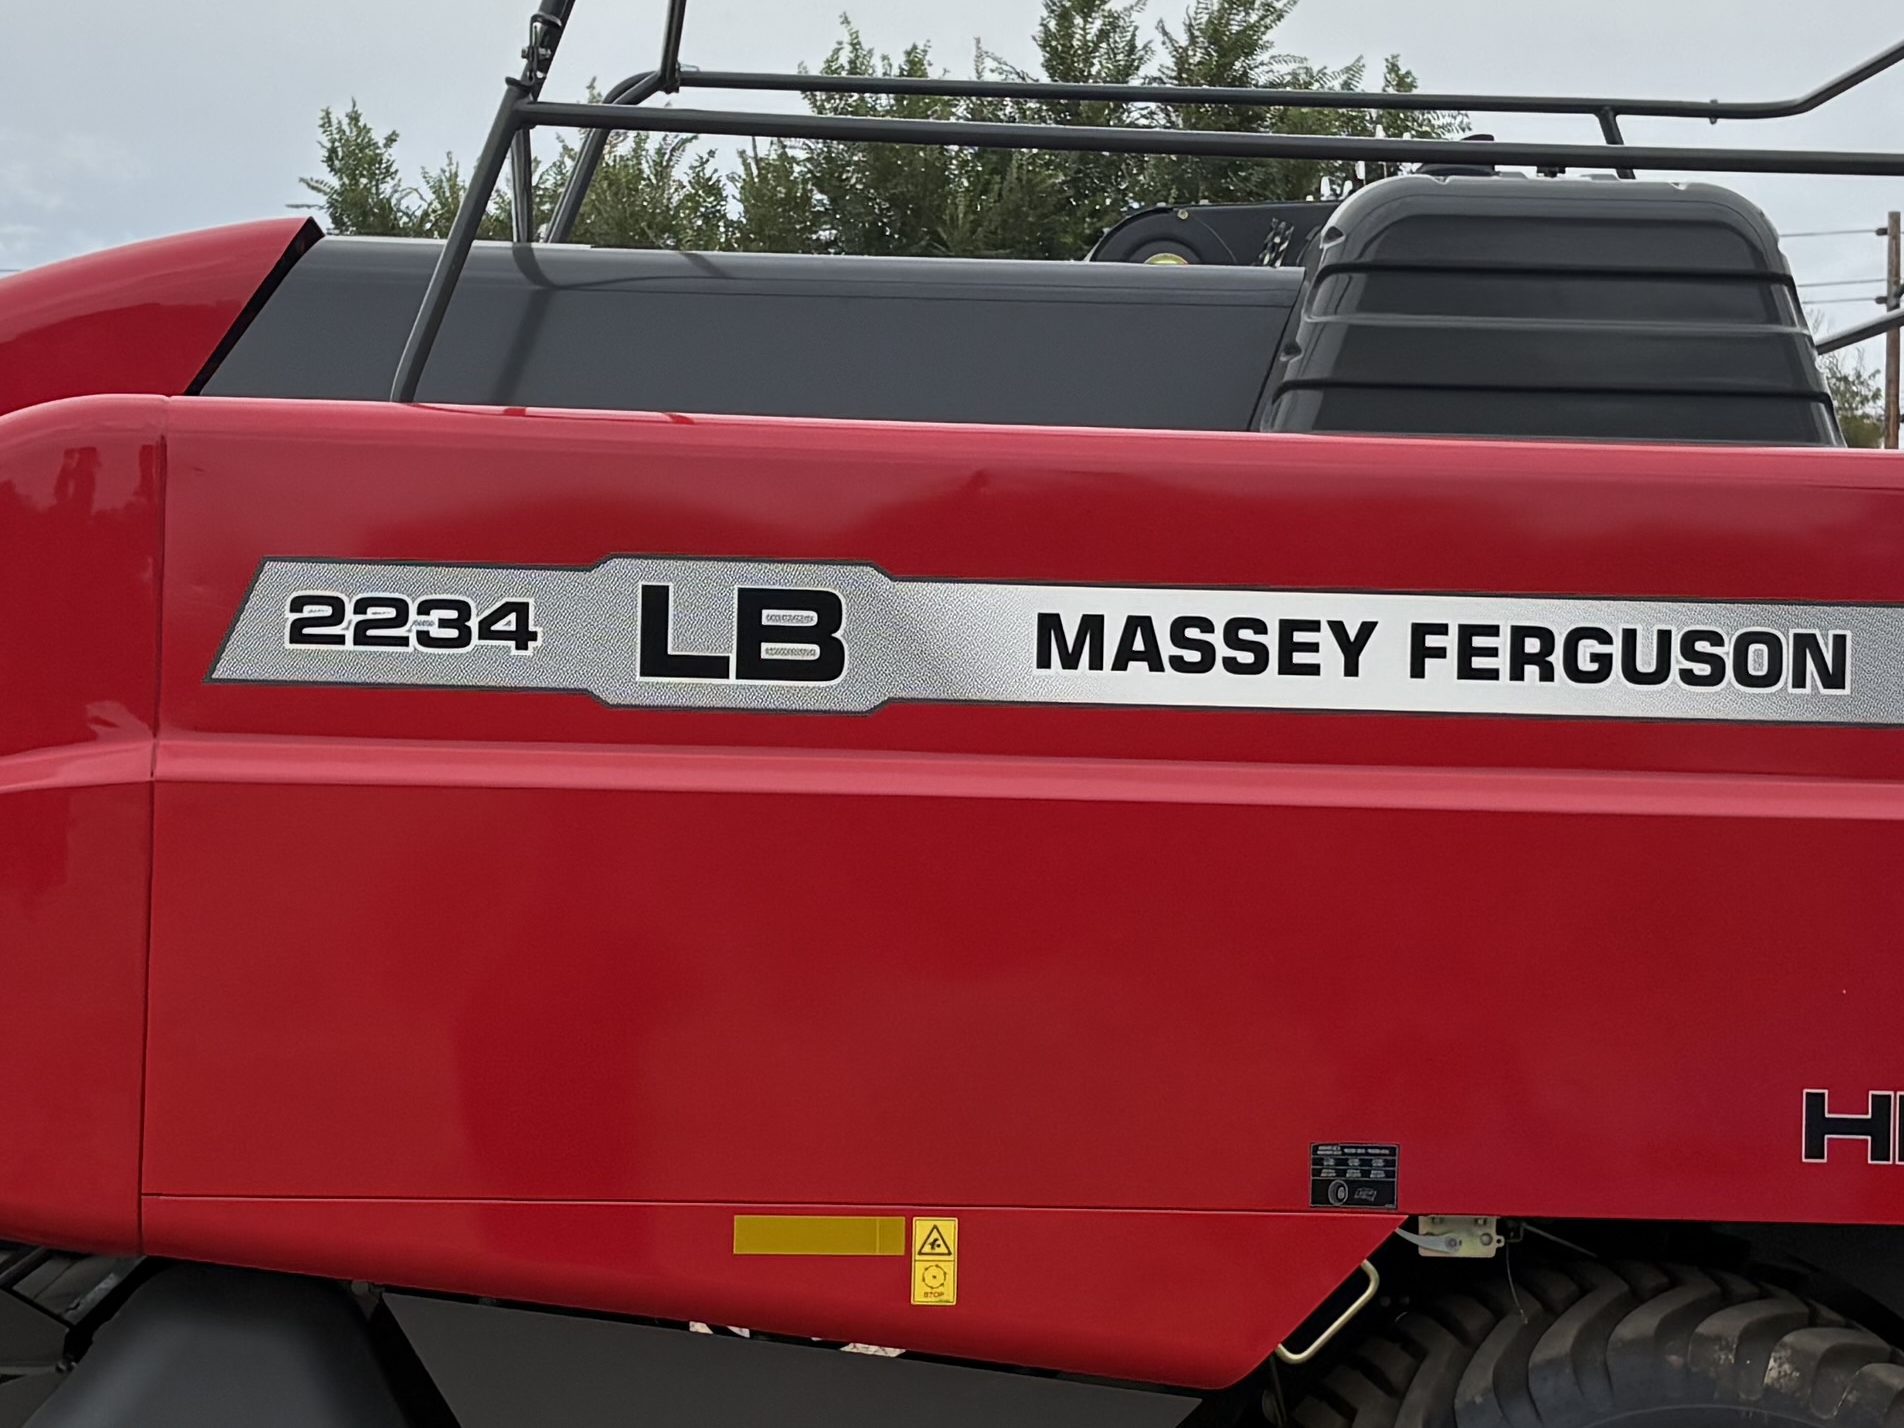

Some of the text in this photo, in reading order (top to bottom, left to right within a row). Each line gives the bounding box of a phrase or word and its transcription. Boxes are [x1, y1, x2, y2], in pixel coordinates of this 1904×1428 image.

[287, 582, 1852, 692] 2234 LB MASSEY FERGUSON
